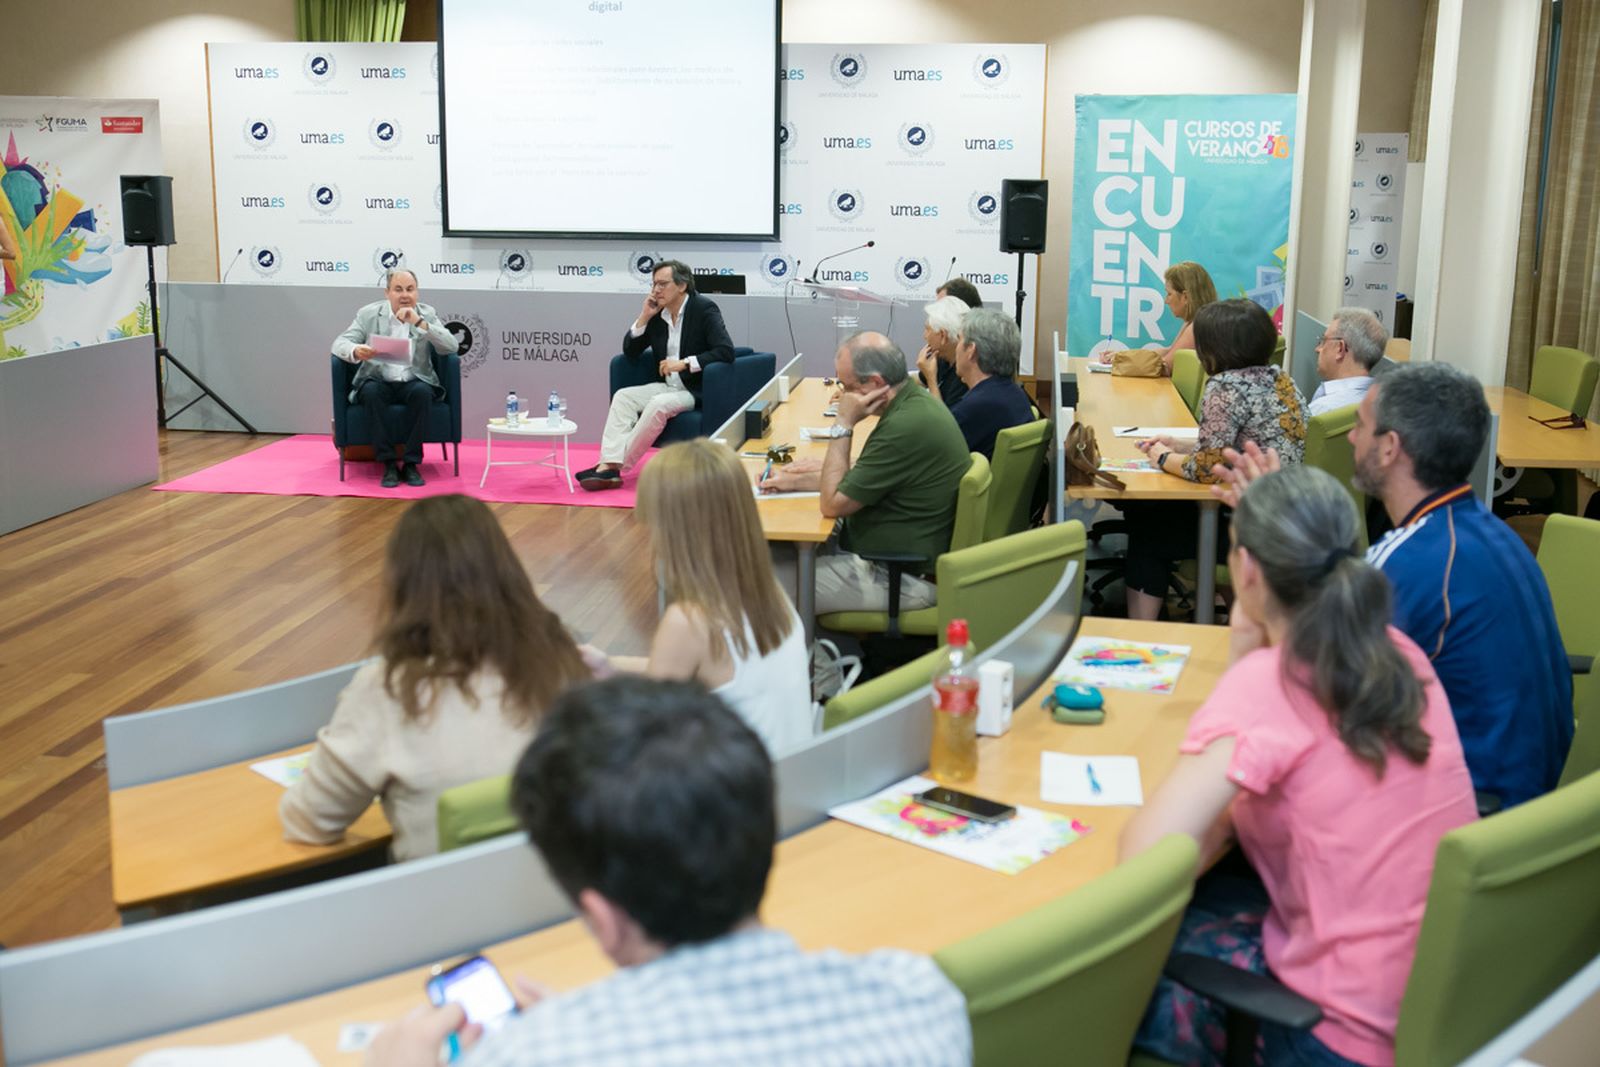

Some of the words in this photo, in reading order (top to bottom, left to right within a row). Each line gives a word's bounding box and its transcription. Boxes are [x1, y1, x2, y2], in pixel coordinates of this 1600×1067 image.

[588, 1, 623, 14] digital
[235, 67, 279, 79] uma.es
[361, 67, 406, 79] uma.es
[781, 69, 805, 80] a.es
[894, 69, 942, 81] uma.es
[56, 118, 87, 126] FGUMA
[1184, 120, 1255, 138] CURSOS
[1260, 120, 1282, 136] DE
[300, 133, 345, 144] uma.es
[824, 137, 872, 149] uma.es
[965, 138, 1014, 150] uma.es
[1097, 120, 1178, 173] EN
[1188, 140, 1260, 158] VERANO
[242, 196, 285, 208] uma.es
[365, 198, 410, 209] uma.es
[1093, 176, 1184, 230] CU
[779, 204, 802, 215] a.es
[891, 204, 938, 217] uma.es
[1093, 230, 1171, 283] EN
[305, 260, 350, 272] uma.es
[430, 263, 475, 274] uma.es
[558, 264, 603, 277] uma.es
[821, 270, 869, 282] uma.es
[1091, 284, 1165, 341] TR
[502, 331, 592, 347] UNIVERSIDAD
[502, 348, 520, 361] DE
[524, 344, 579, 362] MÁLAGA
